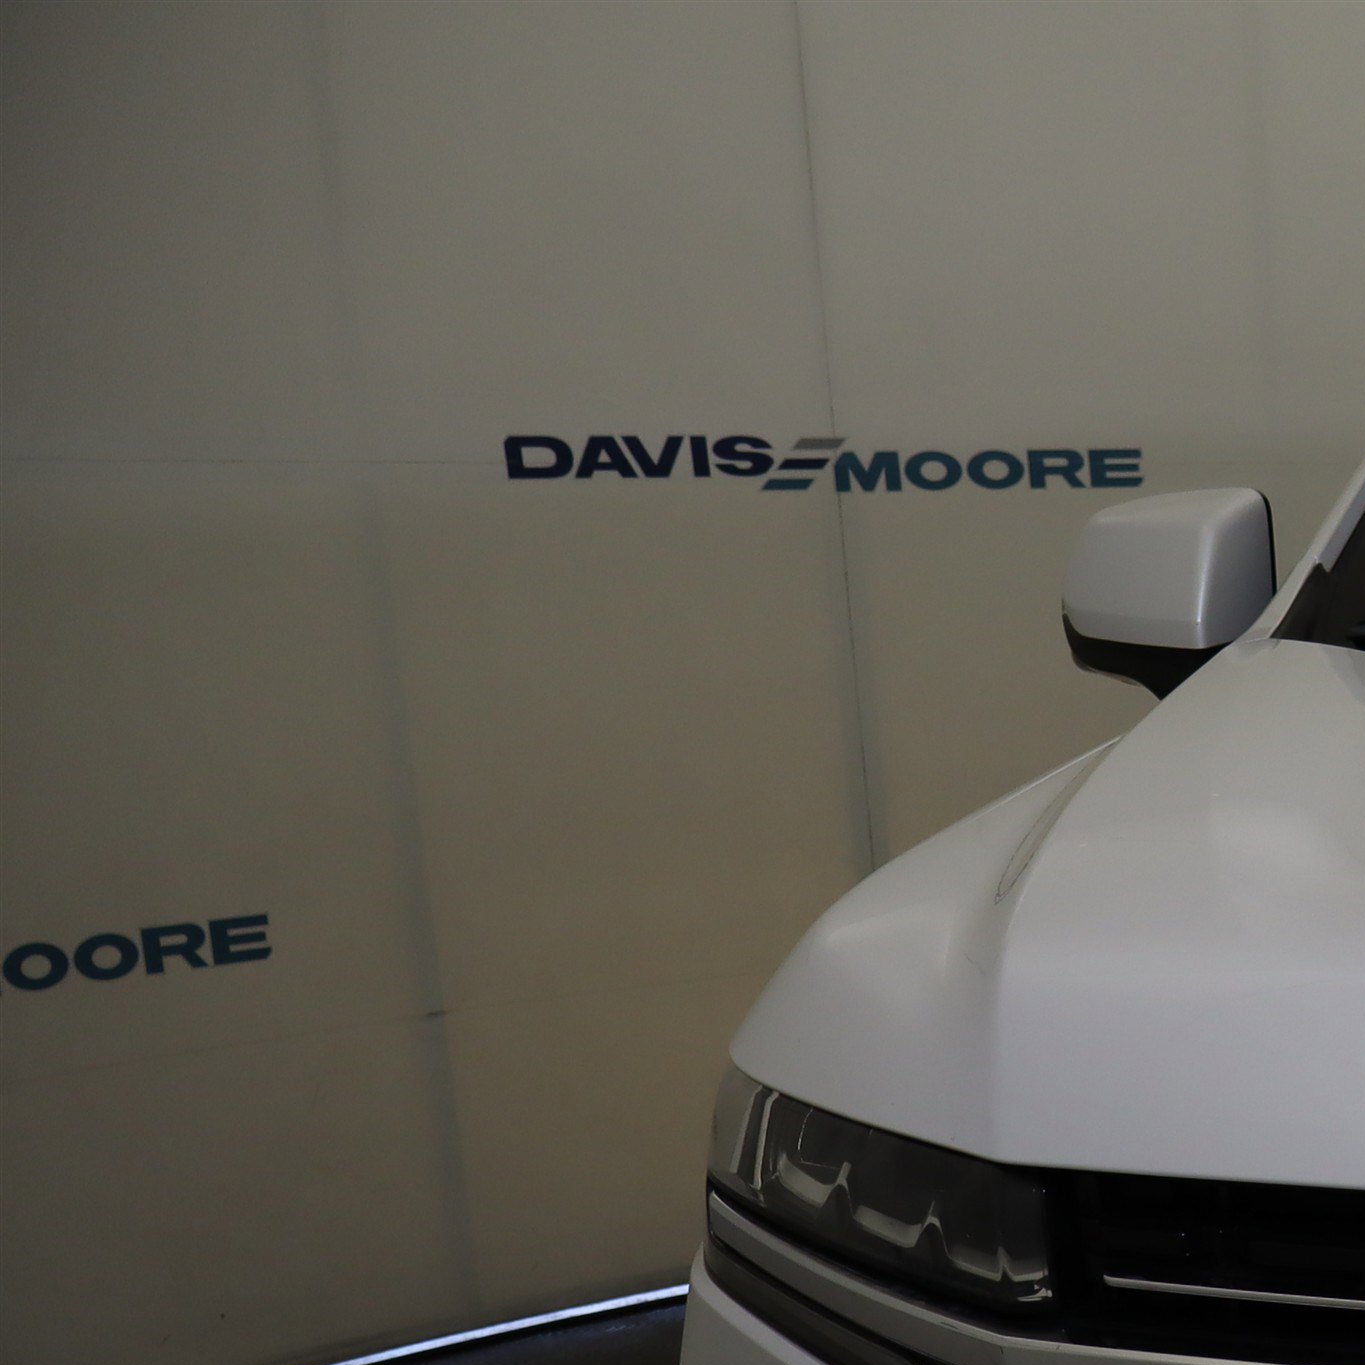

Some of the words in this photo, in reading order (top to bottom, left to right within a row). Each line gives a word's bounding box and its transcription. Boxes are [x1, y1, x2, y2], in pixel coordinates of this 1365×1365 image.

[503, 435, 774, 478] DAVIS
[833, 448, 1144, 492] MOORE
[0, 913, 273, 991] OORE
